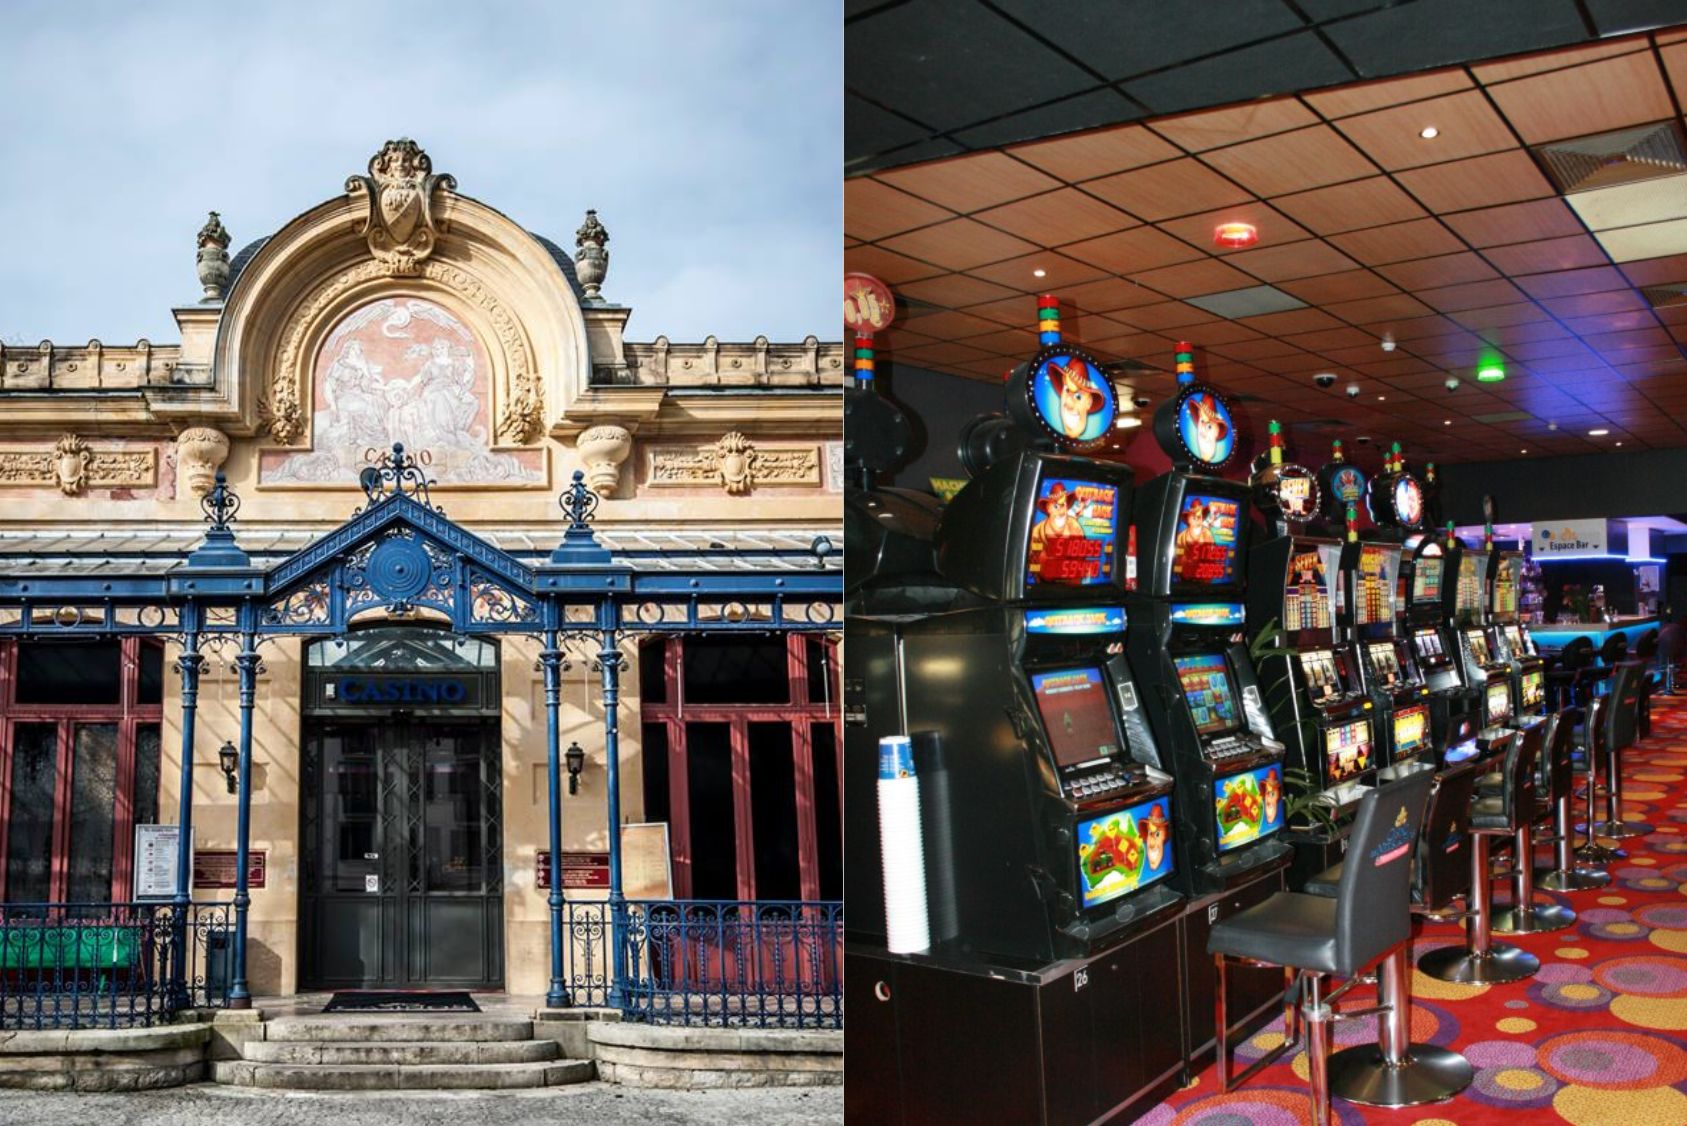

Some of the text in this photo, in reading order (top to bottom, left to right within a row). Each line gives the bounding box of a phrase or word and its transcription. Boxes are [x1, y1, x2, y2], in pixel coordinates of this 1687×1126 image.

[1550, 540, 1588, 551] Espace Bar
[338, 677, 466, 704] CASINO
[1077, 969, 1088, 987] 26
